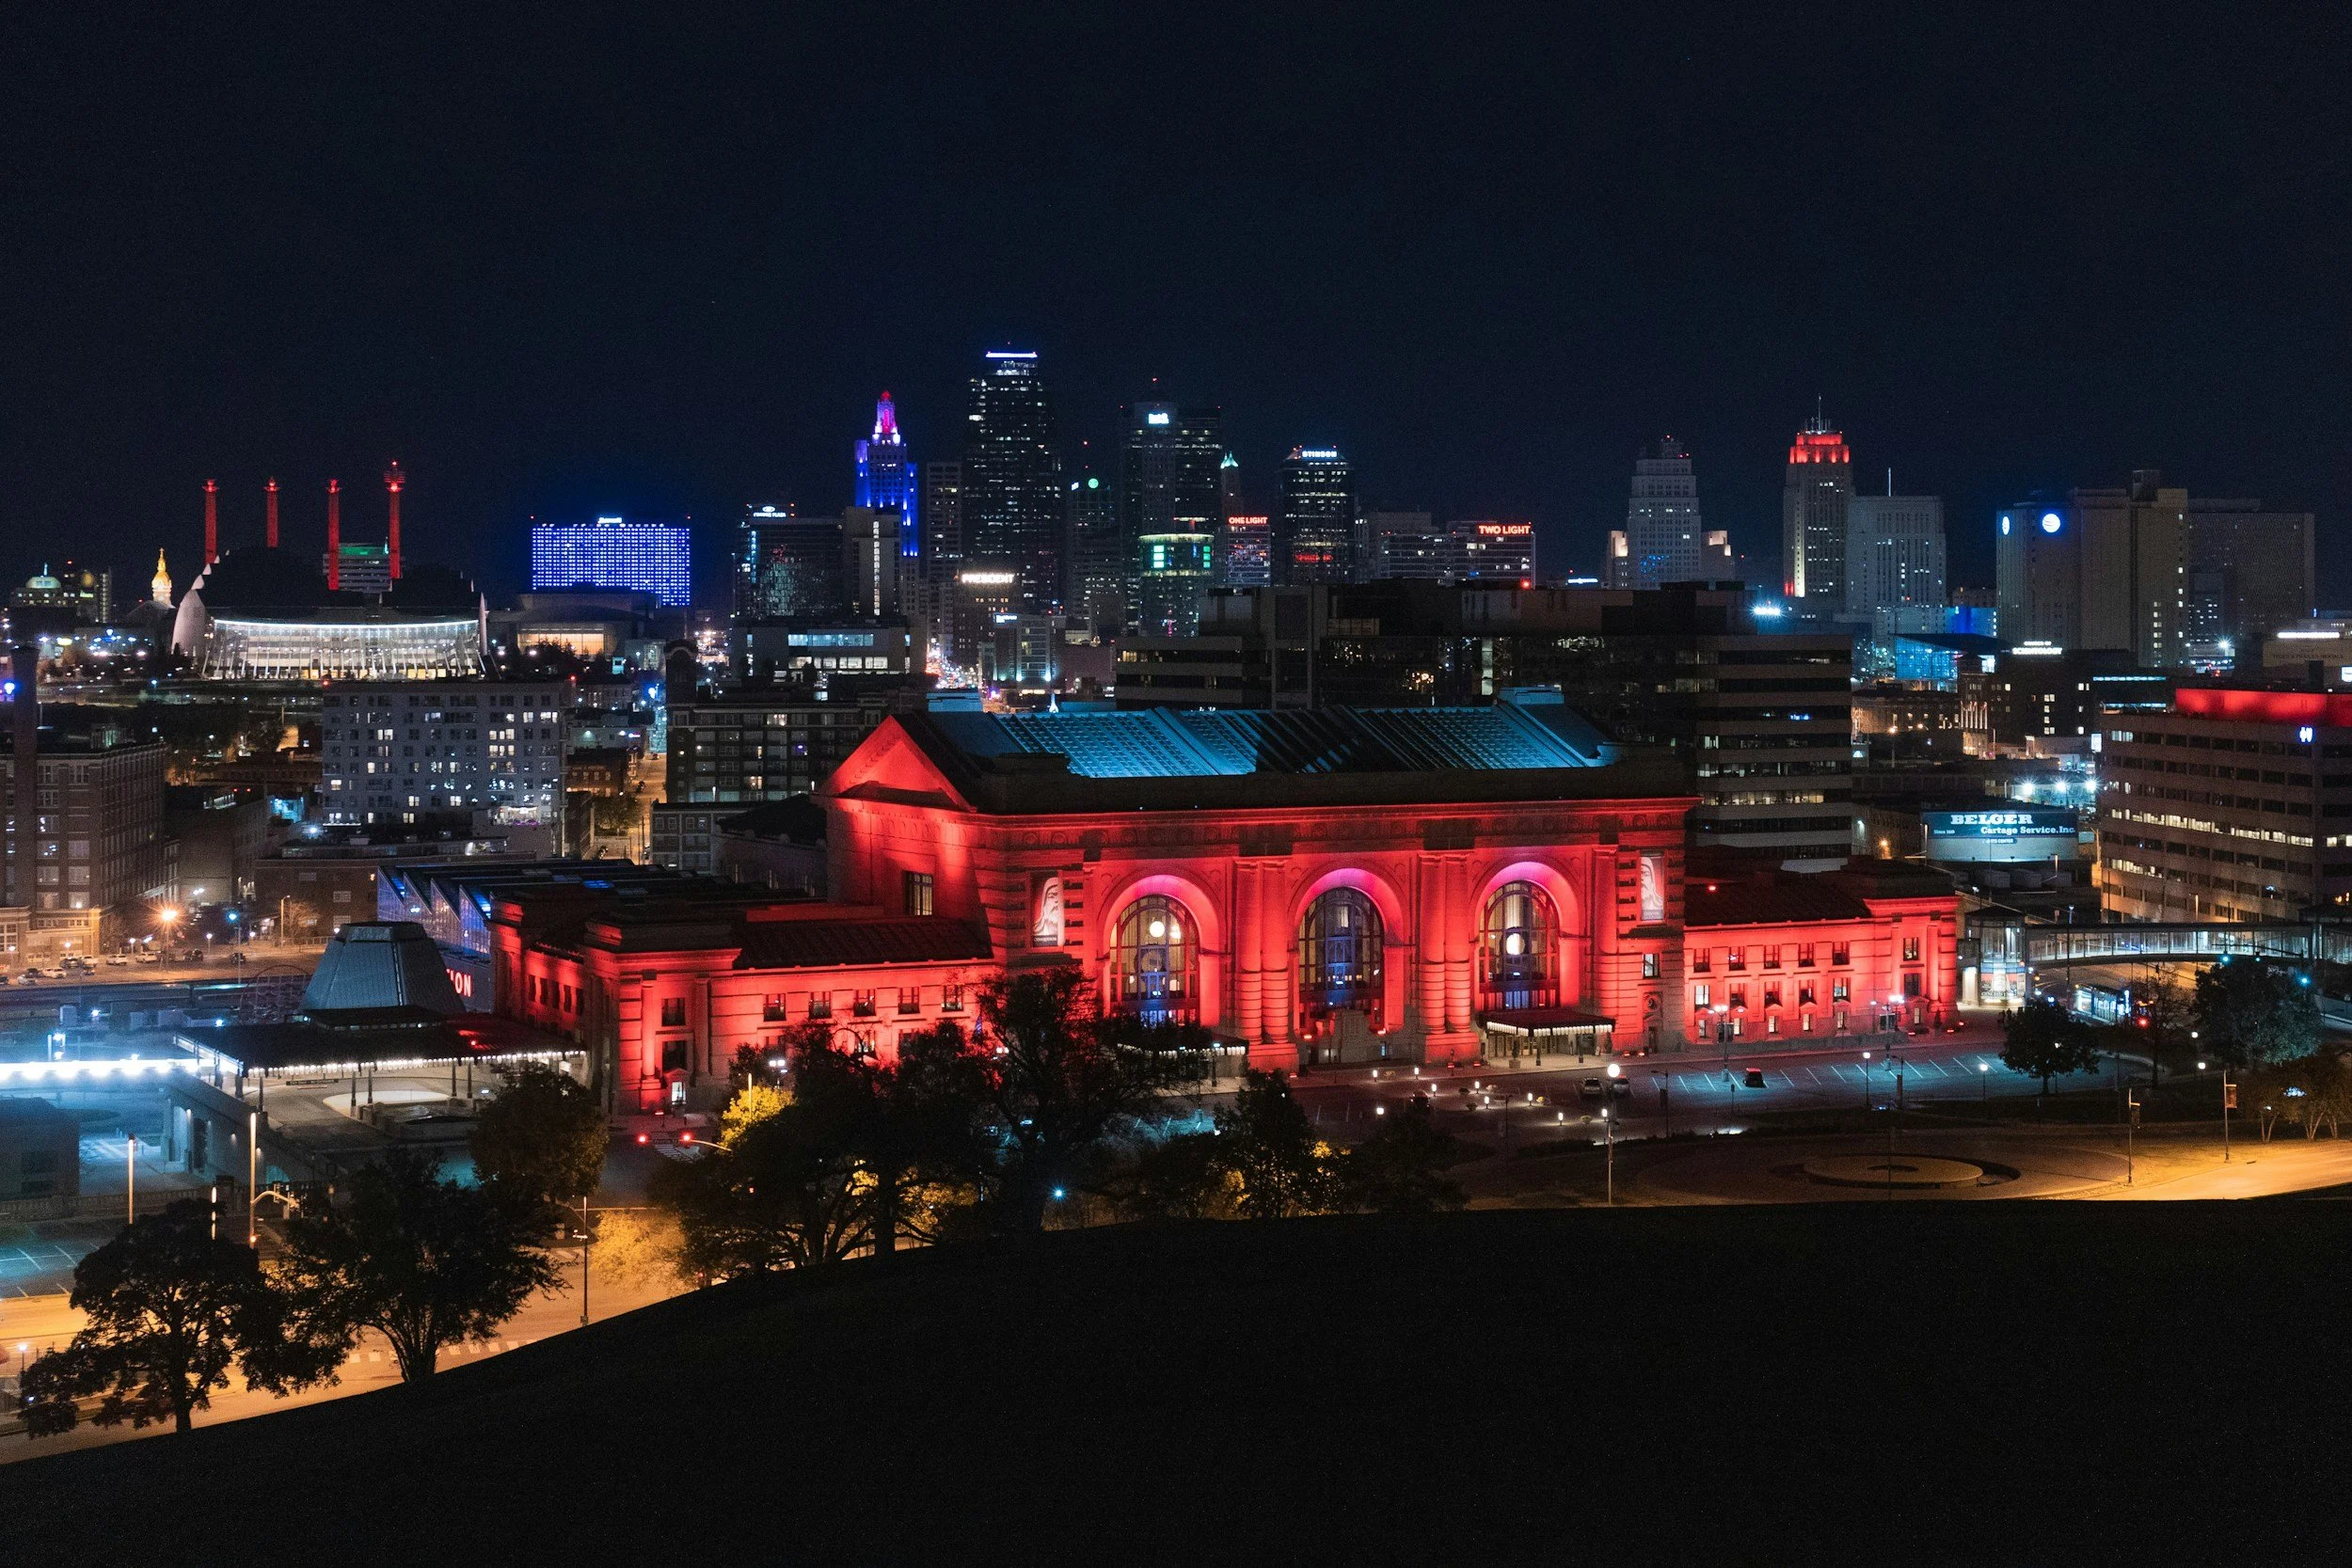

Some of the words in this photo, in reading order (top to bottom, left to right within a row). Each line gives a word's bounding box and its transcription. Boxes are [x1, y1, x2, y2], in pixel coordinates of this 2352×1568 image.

[1229, 516, 1245, 525] ONE
[1246, 516, 1268, 525] LIGHT
[1478, 525, 1502, 534] TWO
[1502, 525, 1531, 534] LIGHT
[1950, 814, 2034, 825] BELGER
[1980, 827, 2018, 835] Cartage
